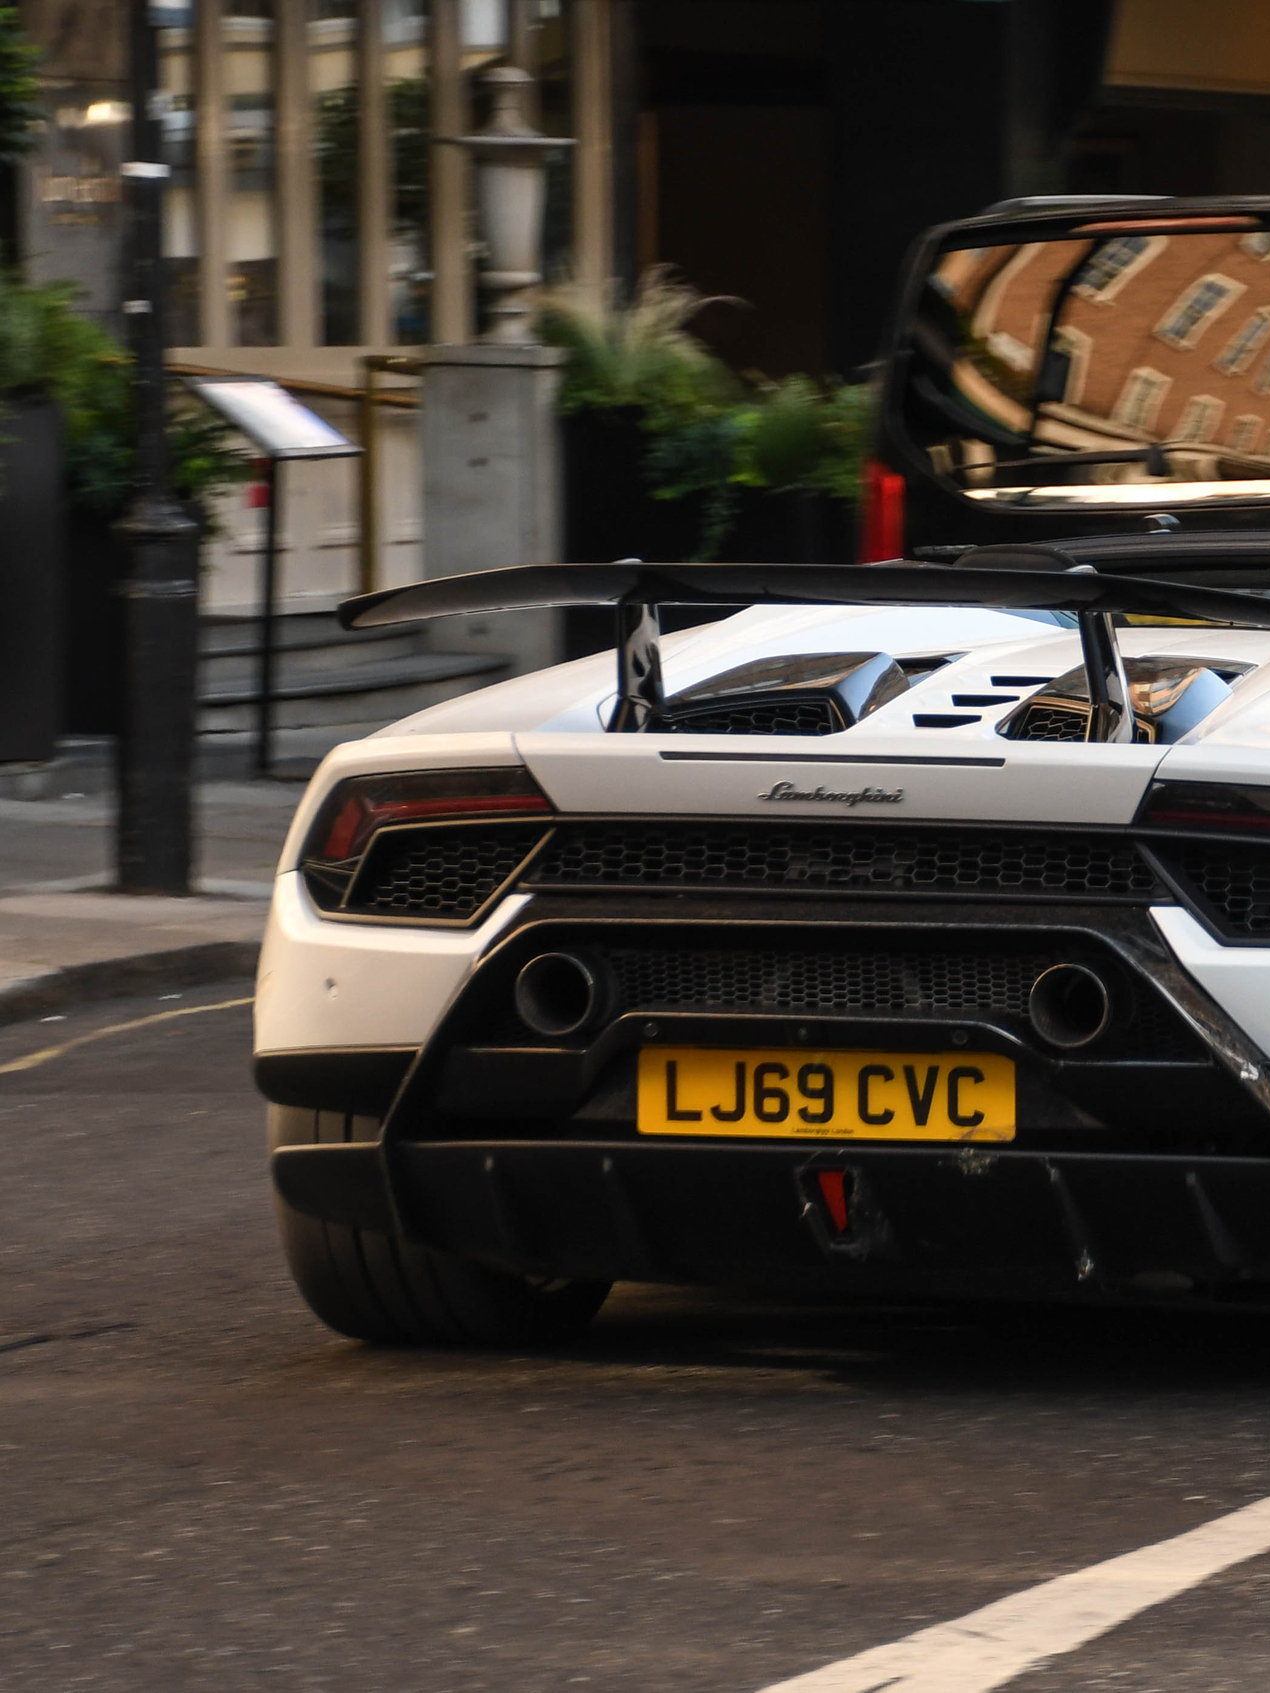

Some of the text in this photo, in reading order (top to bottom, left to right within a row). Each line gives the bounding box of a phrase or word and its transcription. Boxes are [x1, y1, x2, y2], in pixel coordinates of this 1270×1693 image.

[757, 779, 904, 807] Lamborghini
[666, 1060, 986, 1127] LJ69 CVC
